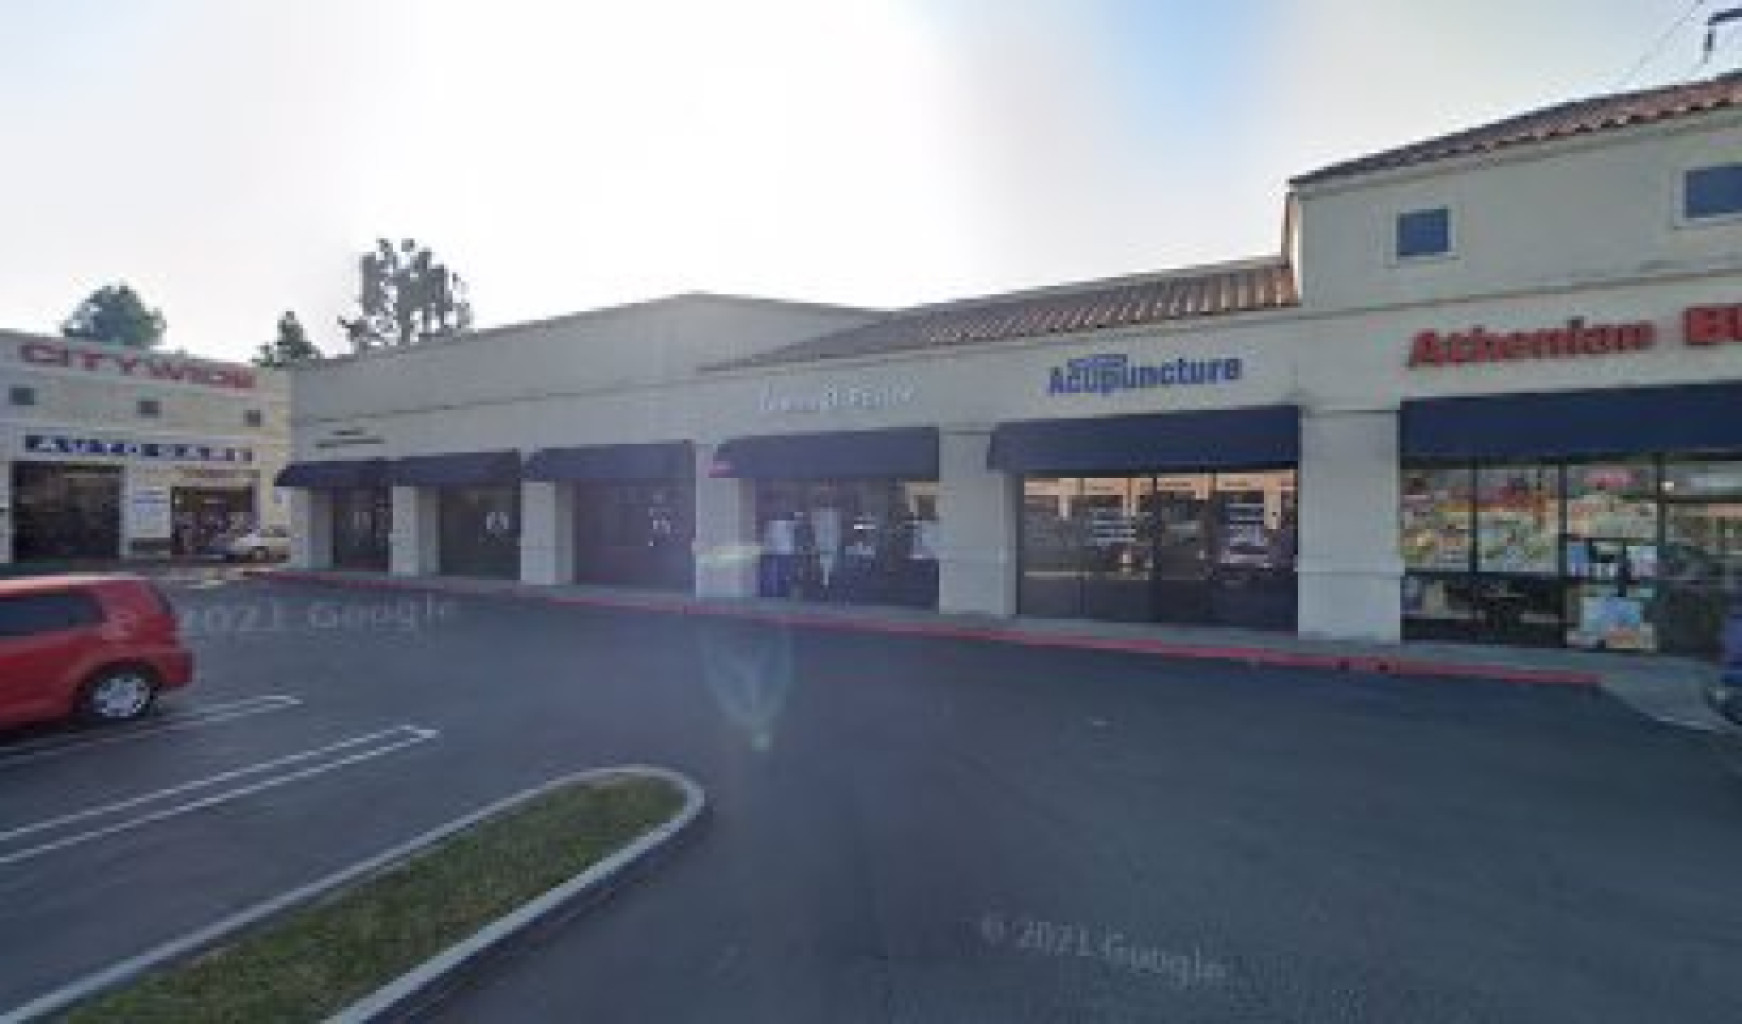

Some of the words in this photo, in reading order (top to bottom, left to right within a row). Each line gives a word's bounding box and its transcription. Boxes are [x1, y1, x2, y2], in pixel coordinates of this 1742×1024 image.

[20, 342, 256, 389] CITYWIDE
[1408, 317, 1656, 370] Athenian
[1048, 354, 1241, 397] Acupuncture
